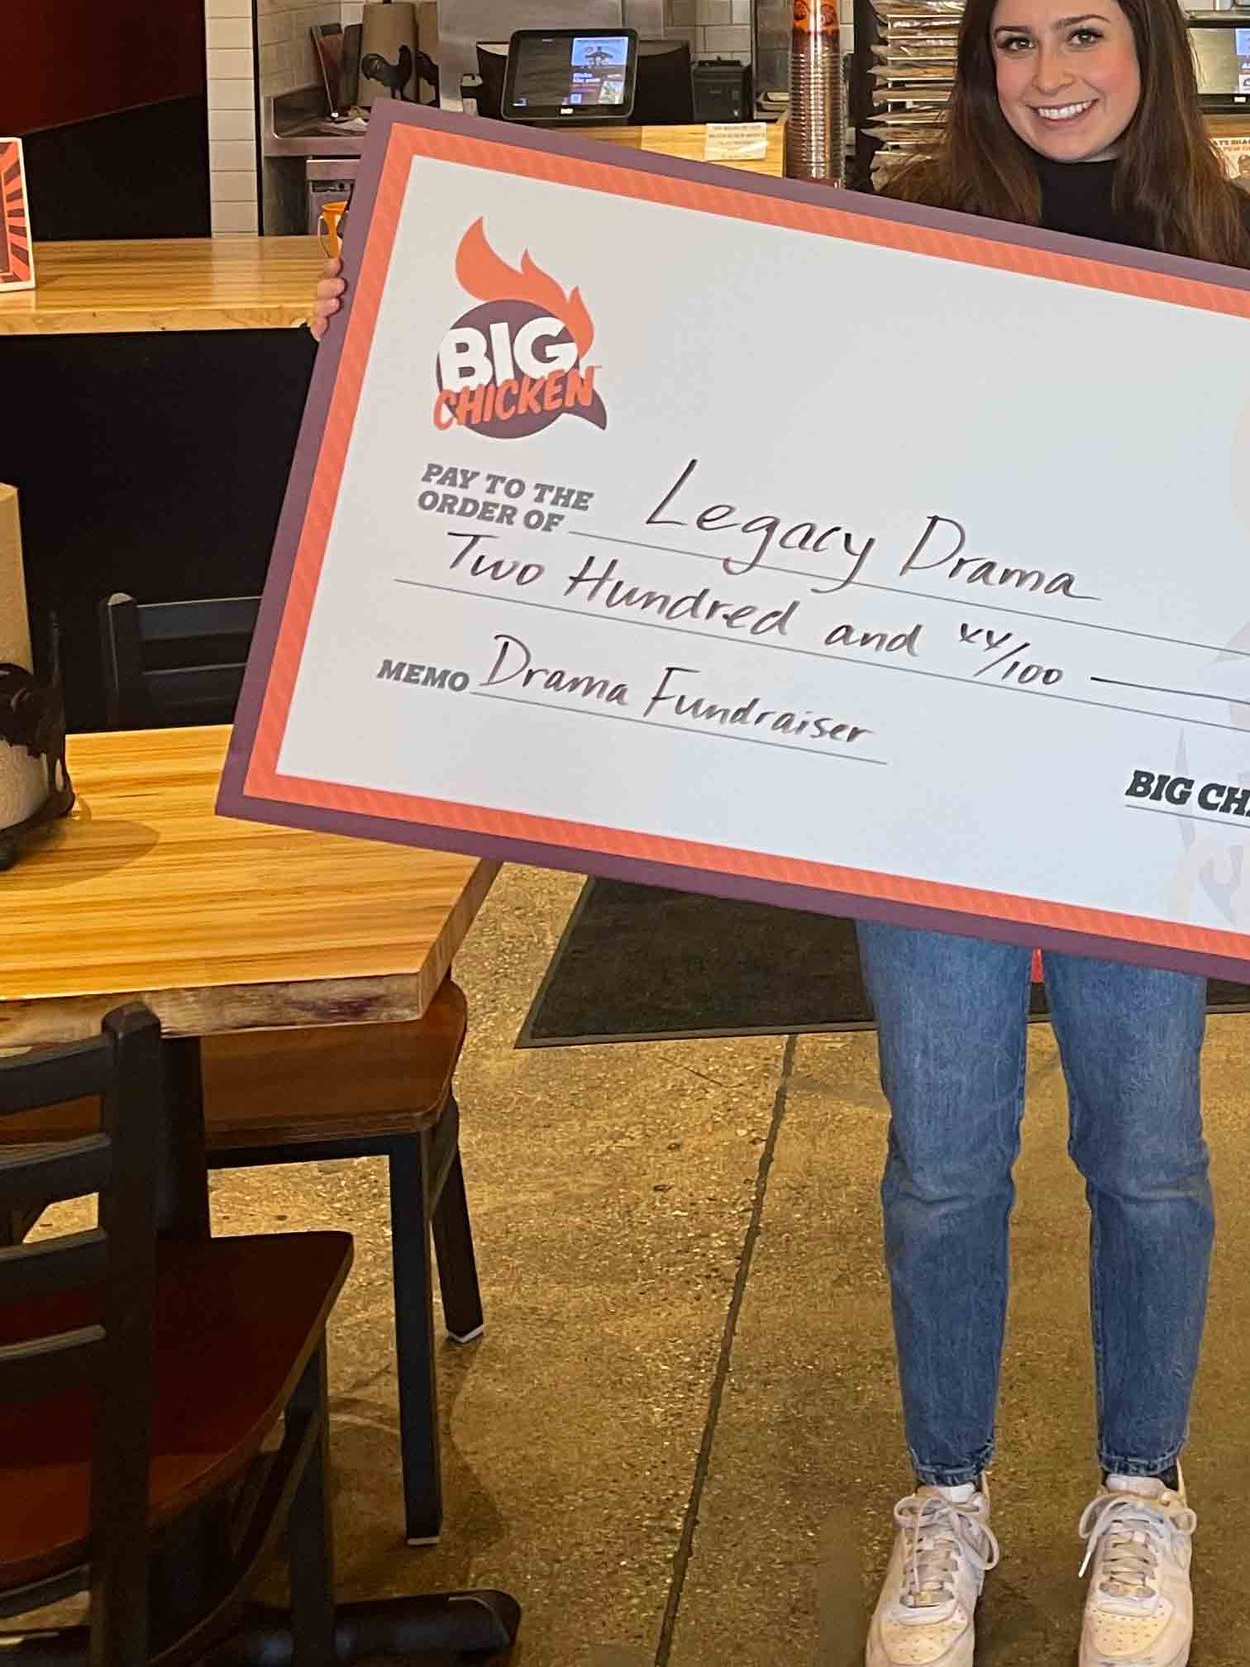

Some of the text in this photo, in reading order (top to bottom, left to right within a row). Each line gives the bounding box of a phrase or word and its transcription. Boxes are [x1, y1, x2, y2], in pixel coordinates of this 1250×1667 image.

[440, 316, 578, 393] BIG
[433, 366, 595, 431] CHICKEN
[418, 490, 565, 534] ORDER OF
[421, 463, 594, 511] PAY TO THE
[646, 457, 1091, 601] Legacy Drama
[446, 530, 544, 586] Two
[564, 555, 798, 637] Hundred
[824, 620, 919, 656] and
[377, 659, 470, 693] MEMO
[479, 634, 875, 745] Drama Fundraiser
[1126, 770, 1194, 806] BIG
